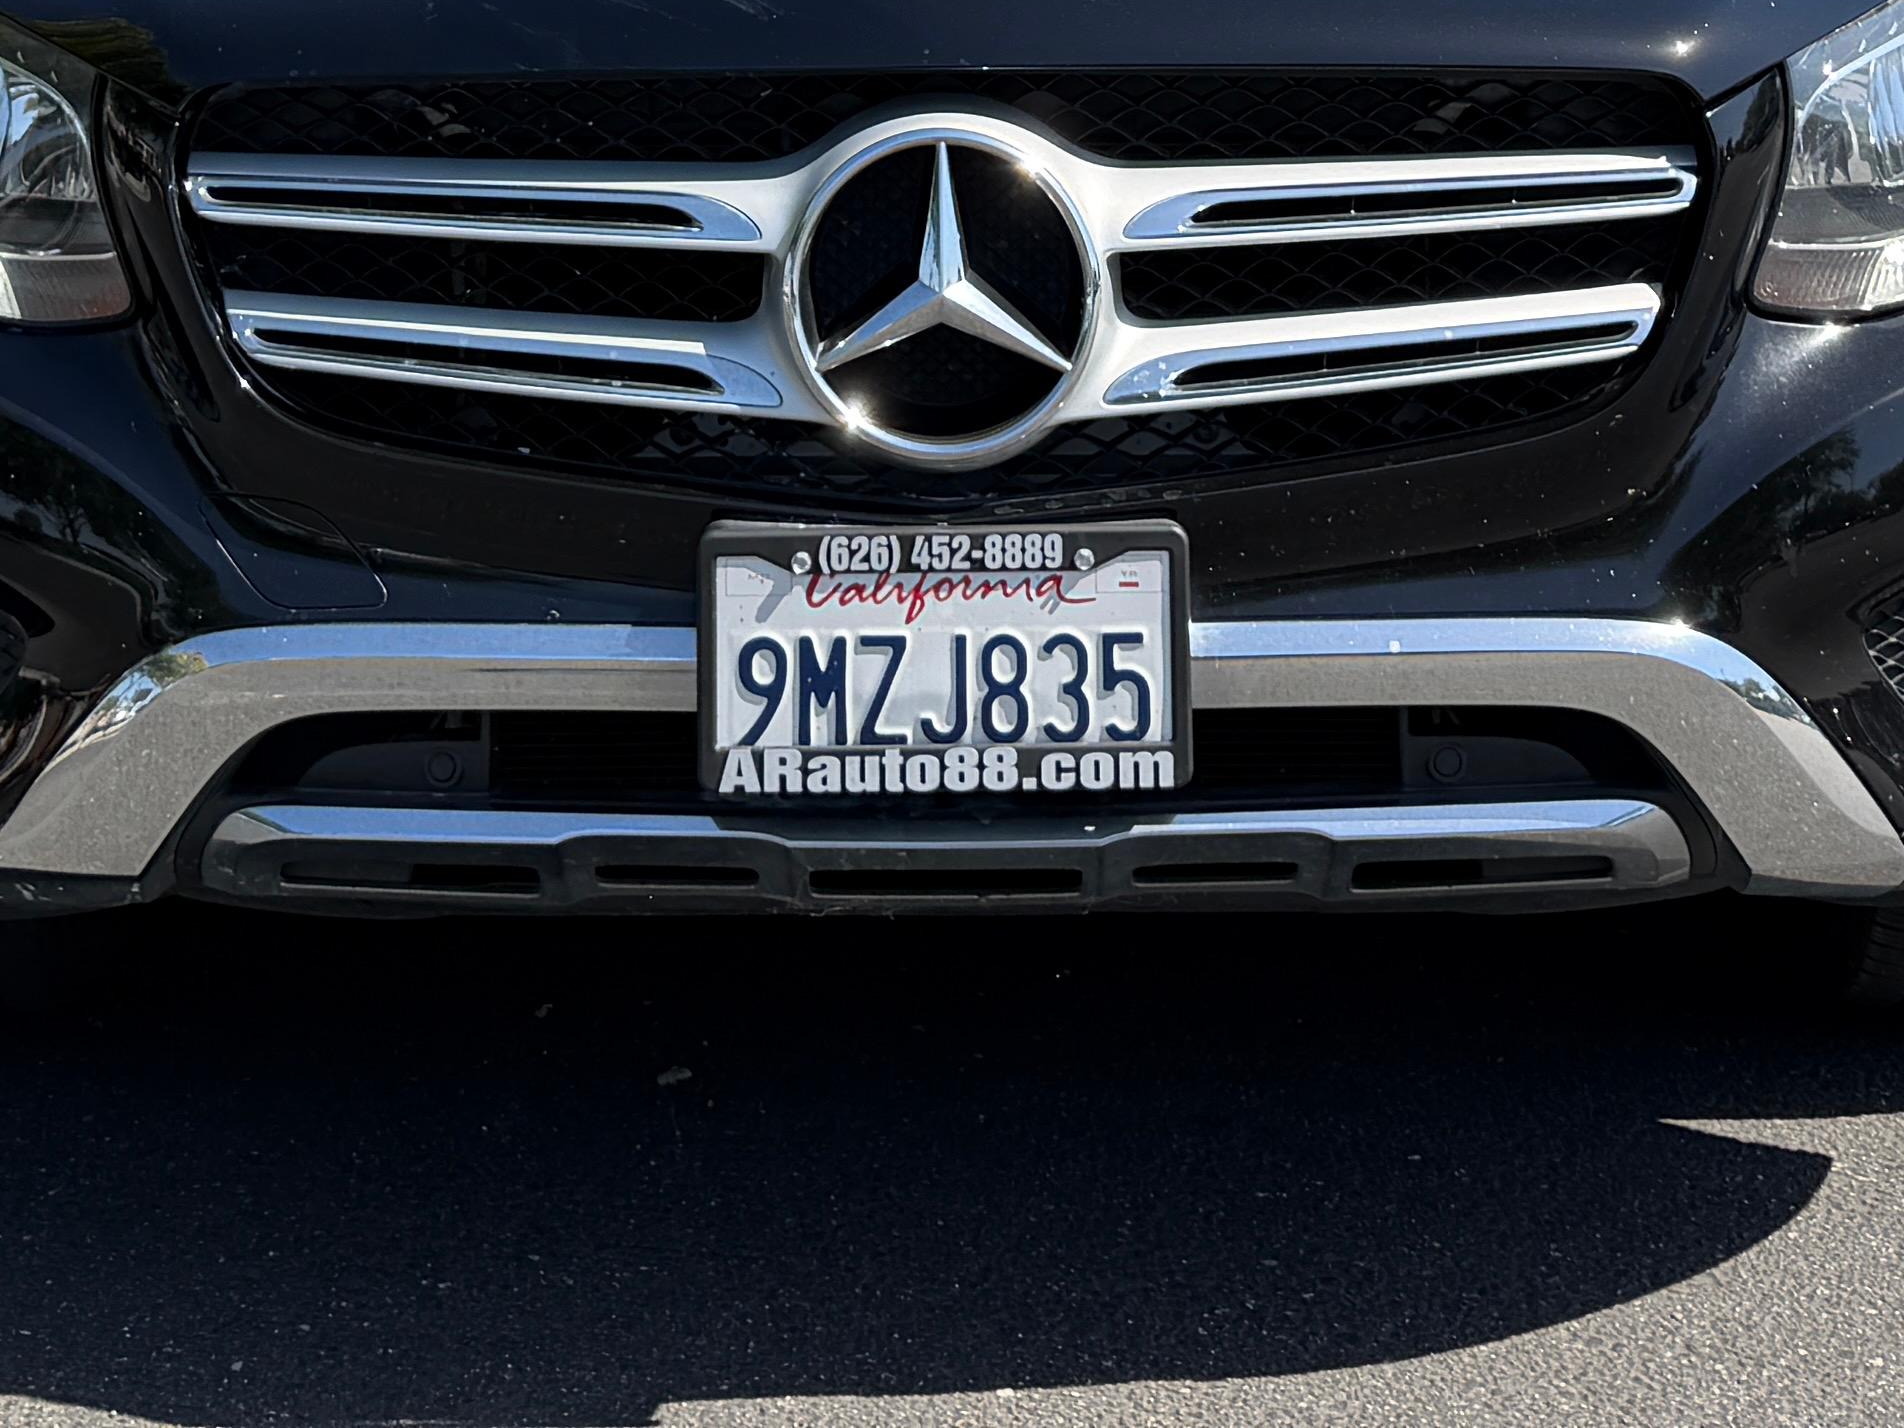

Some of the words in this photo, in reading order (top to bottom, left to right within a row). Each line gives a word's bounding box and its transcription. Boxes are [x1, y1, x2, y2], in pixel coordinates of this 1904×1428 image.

[817, 534, 901, 574] (626)
[911, 532, 1064, 571] 452-8889
[804, 571, 1097, 625] California
[737, 631, 1153, 746] 9MZJ835
[718, 746, 1176, 794] ARauto88.com
